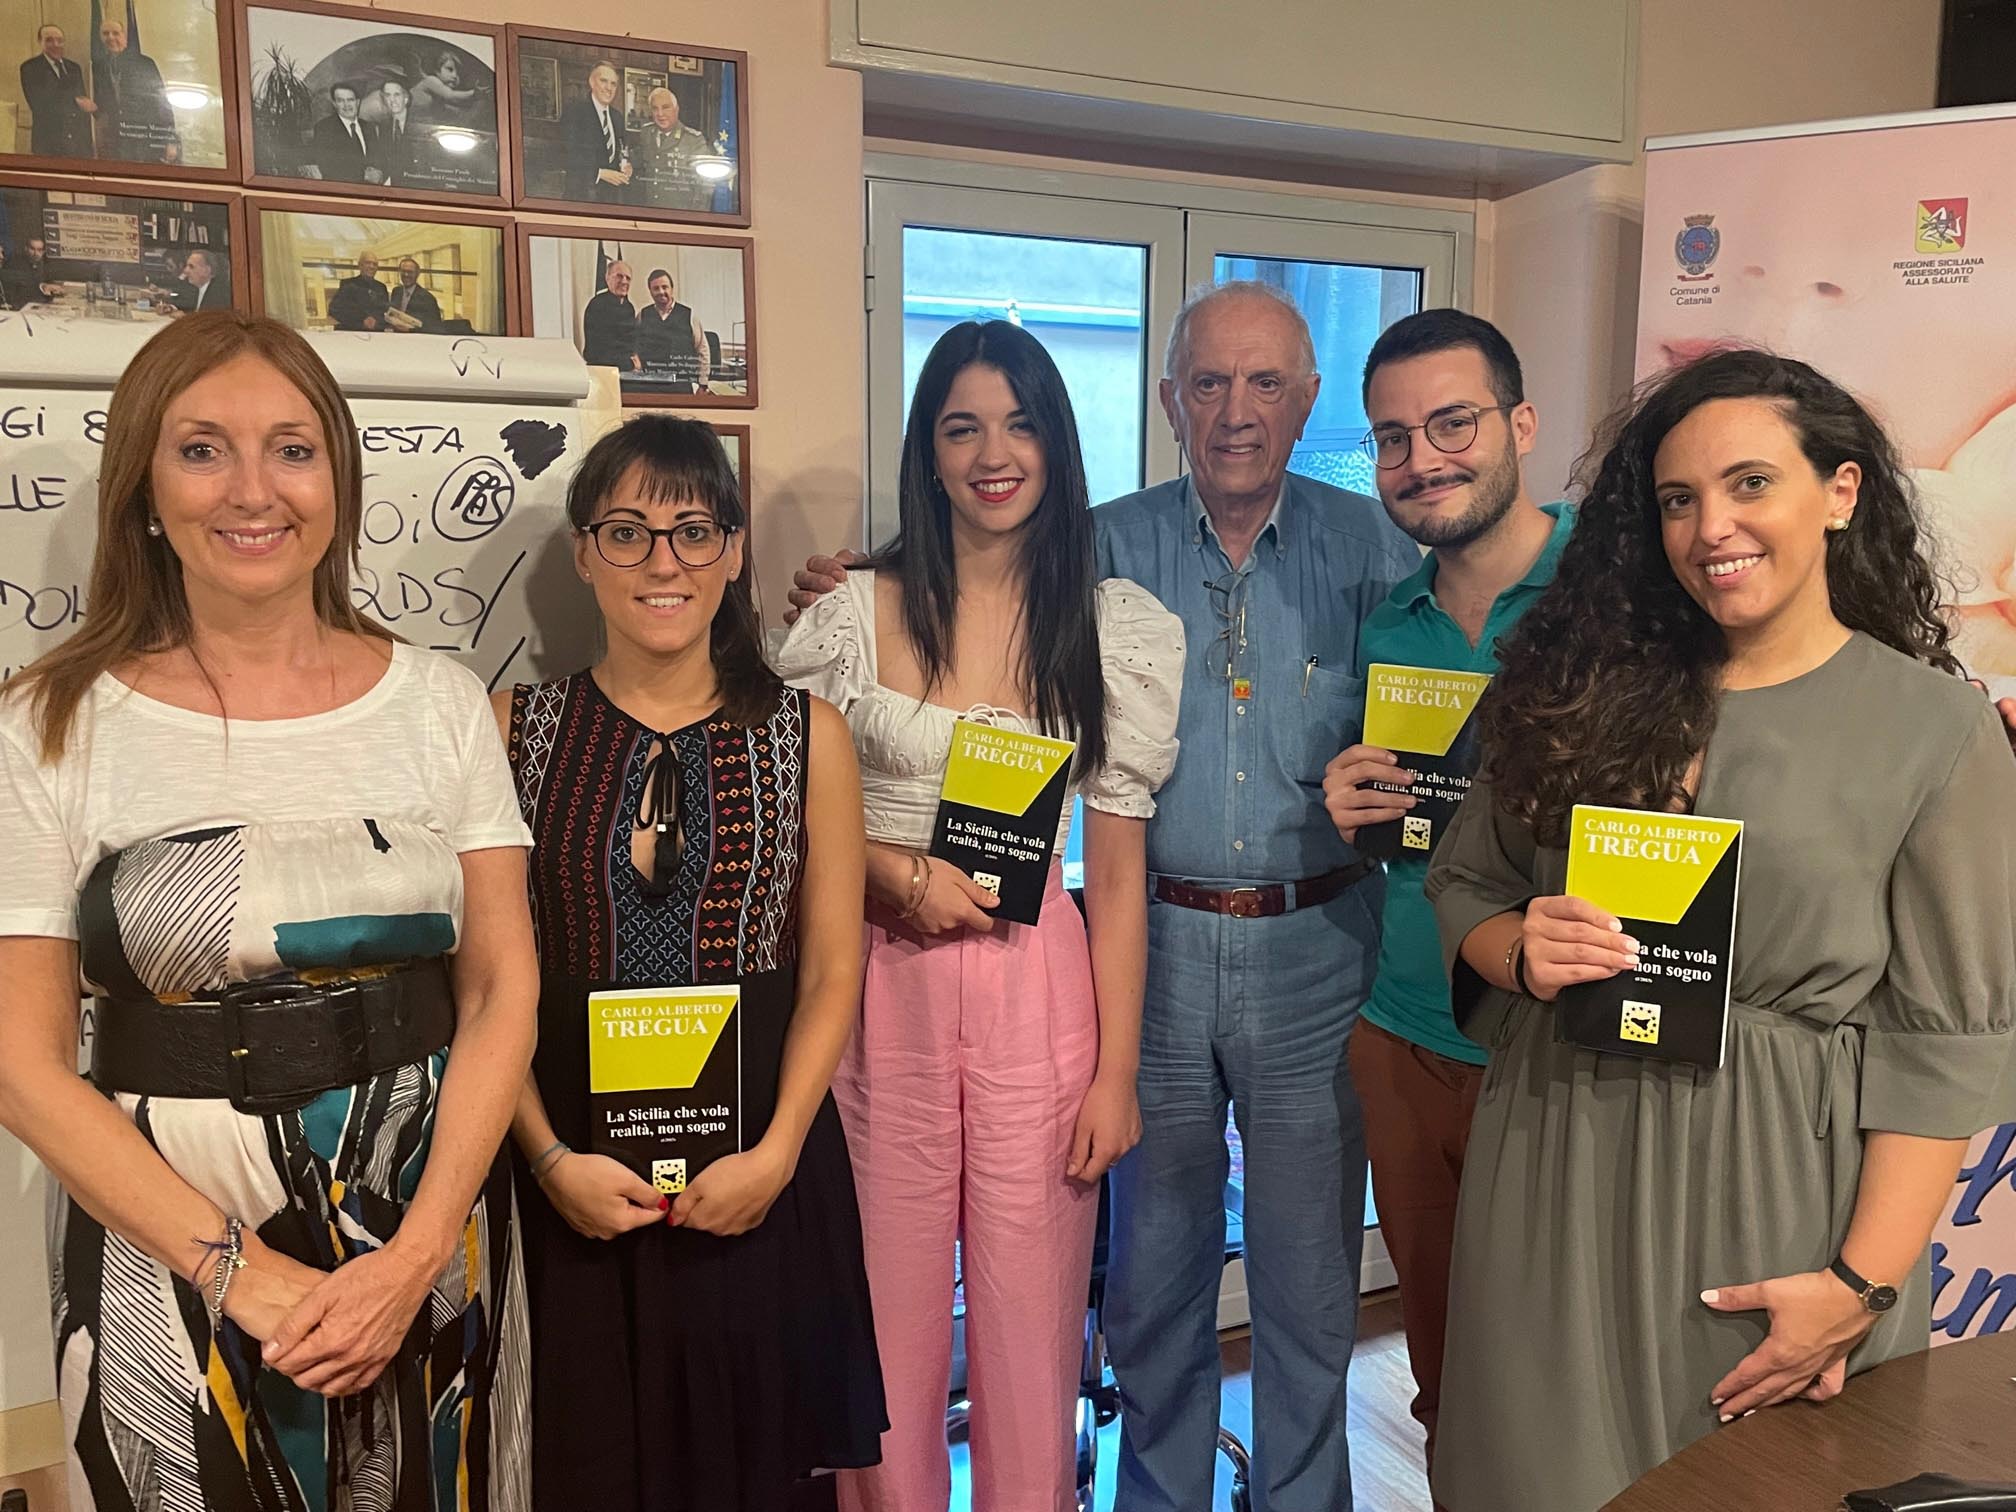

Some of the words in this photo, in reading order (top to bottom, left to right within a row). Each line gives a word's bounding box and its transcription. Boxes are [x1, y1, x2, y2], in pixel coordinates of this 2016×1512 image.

[1893, 260, 1935, 269] REGIONE
[1937, 257, 1984, 267] SICILIANA
[1902, 266, 1974, 277] ASSESSORATO
[1669, 287, 1709, 296] Comune
[1711, 284, 1720, 294] di
[1905, 277, 1929, 286] ALLA
[1932, 275, 1969, 284] SALUTE
[1676, 296, 1712, 305] Catania
[360, 426, 464, 453] ESTA
[1378, 673, 1419, 687] CARLO
[1422, 679, 1477, 693] ALBERTO
[1377, 686, 1462, 709] TREGUA
[964, 729, 1005, 746] CARLO
[1007, 740, 1060, 759] ALBERTO
[963, 741, 1045, 774] TREGUA
[1426, 771, 1445, 784] che
[1449, 775, 1472, 788] vola
[1412, 786, 1432, 797] non
[947, 817, 961, 831] La
[964, 821, 998, 839] Sicilia
[1001, 830, 1020, 844] che
[1022, 835, 1046, 850] vola
[1584, 818, 1641, 836] CARLO
[1644, 826, 1721, 844] ALBERTO
[947, 833, 982, 851] realtà,
[984, 841, 1006, 855] non
[1008, 847, 1040, 862] sogno
[1584, 833, 1702, 865] TREGUA
[1653, 943, 1680, 960] che
[1684, 949, 1717, 965] vola
[1665, 965, 1712, 983] sogno
[601, 1005, 652, 1019] CARLO
[655, 1003, 723, 1016] ALBERTO
[602, 1018, 708, 1038] TREGUA
[606, 1110, 625, 1123] La
[628, 1107, 670, 1122] Sicilia
[673, 1105, 698, 1119] che
[701, 1104, 730, 1117] vola
[610, 1122, 654, 1139] realtà,
[657, 1122, 684, 1135] non
[686, 1120, 727, 1136] sogno
